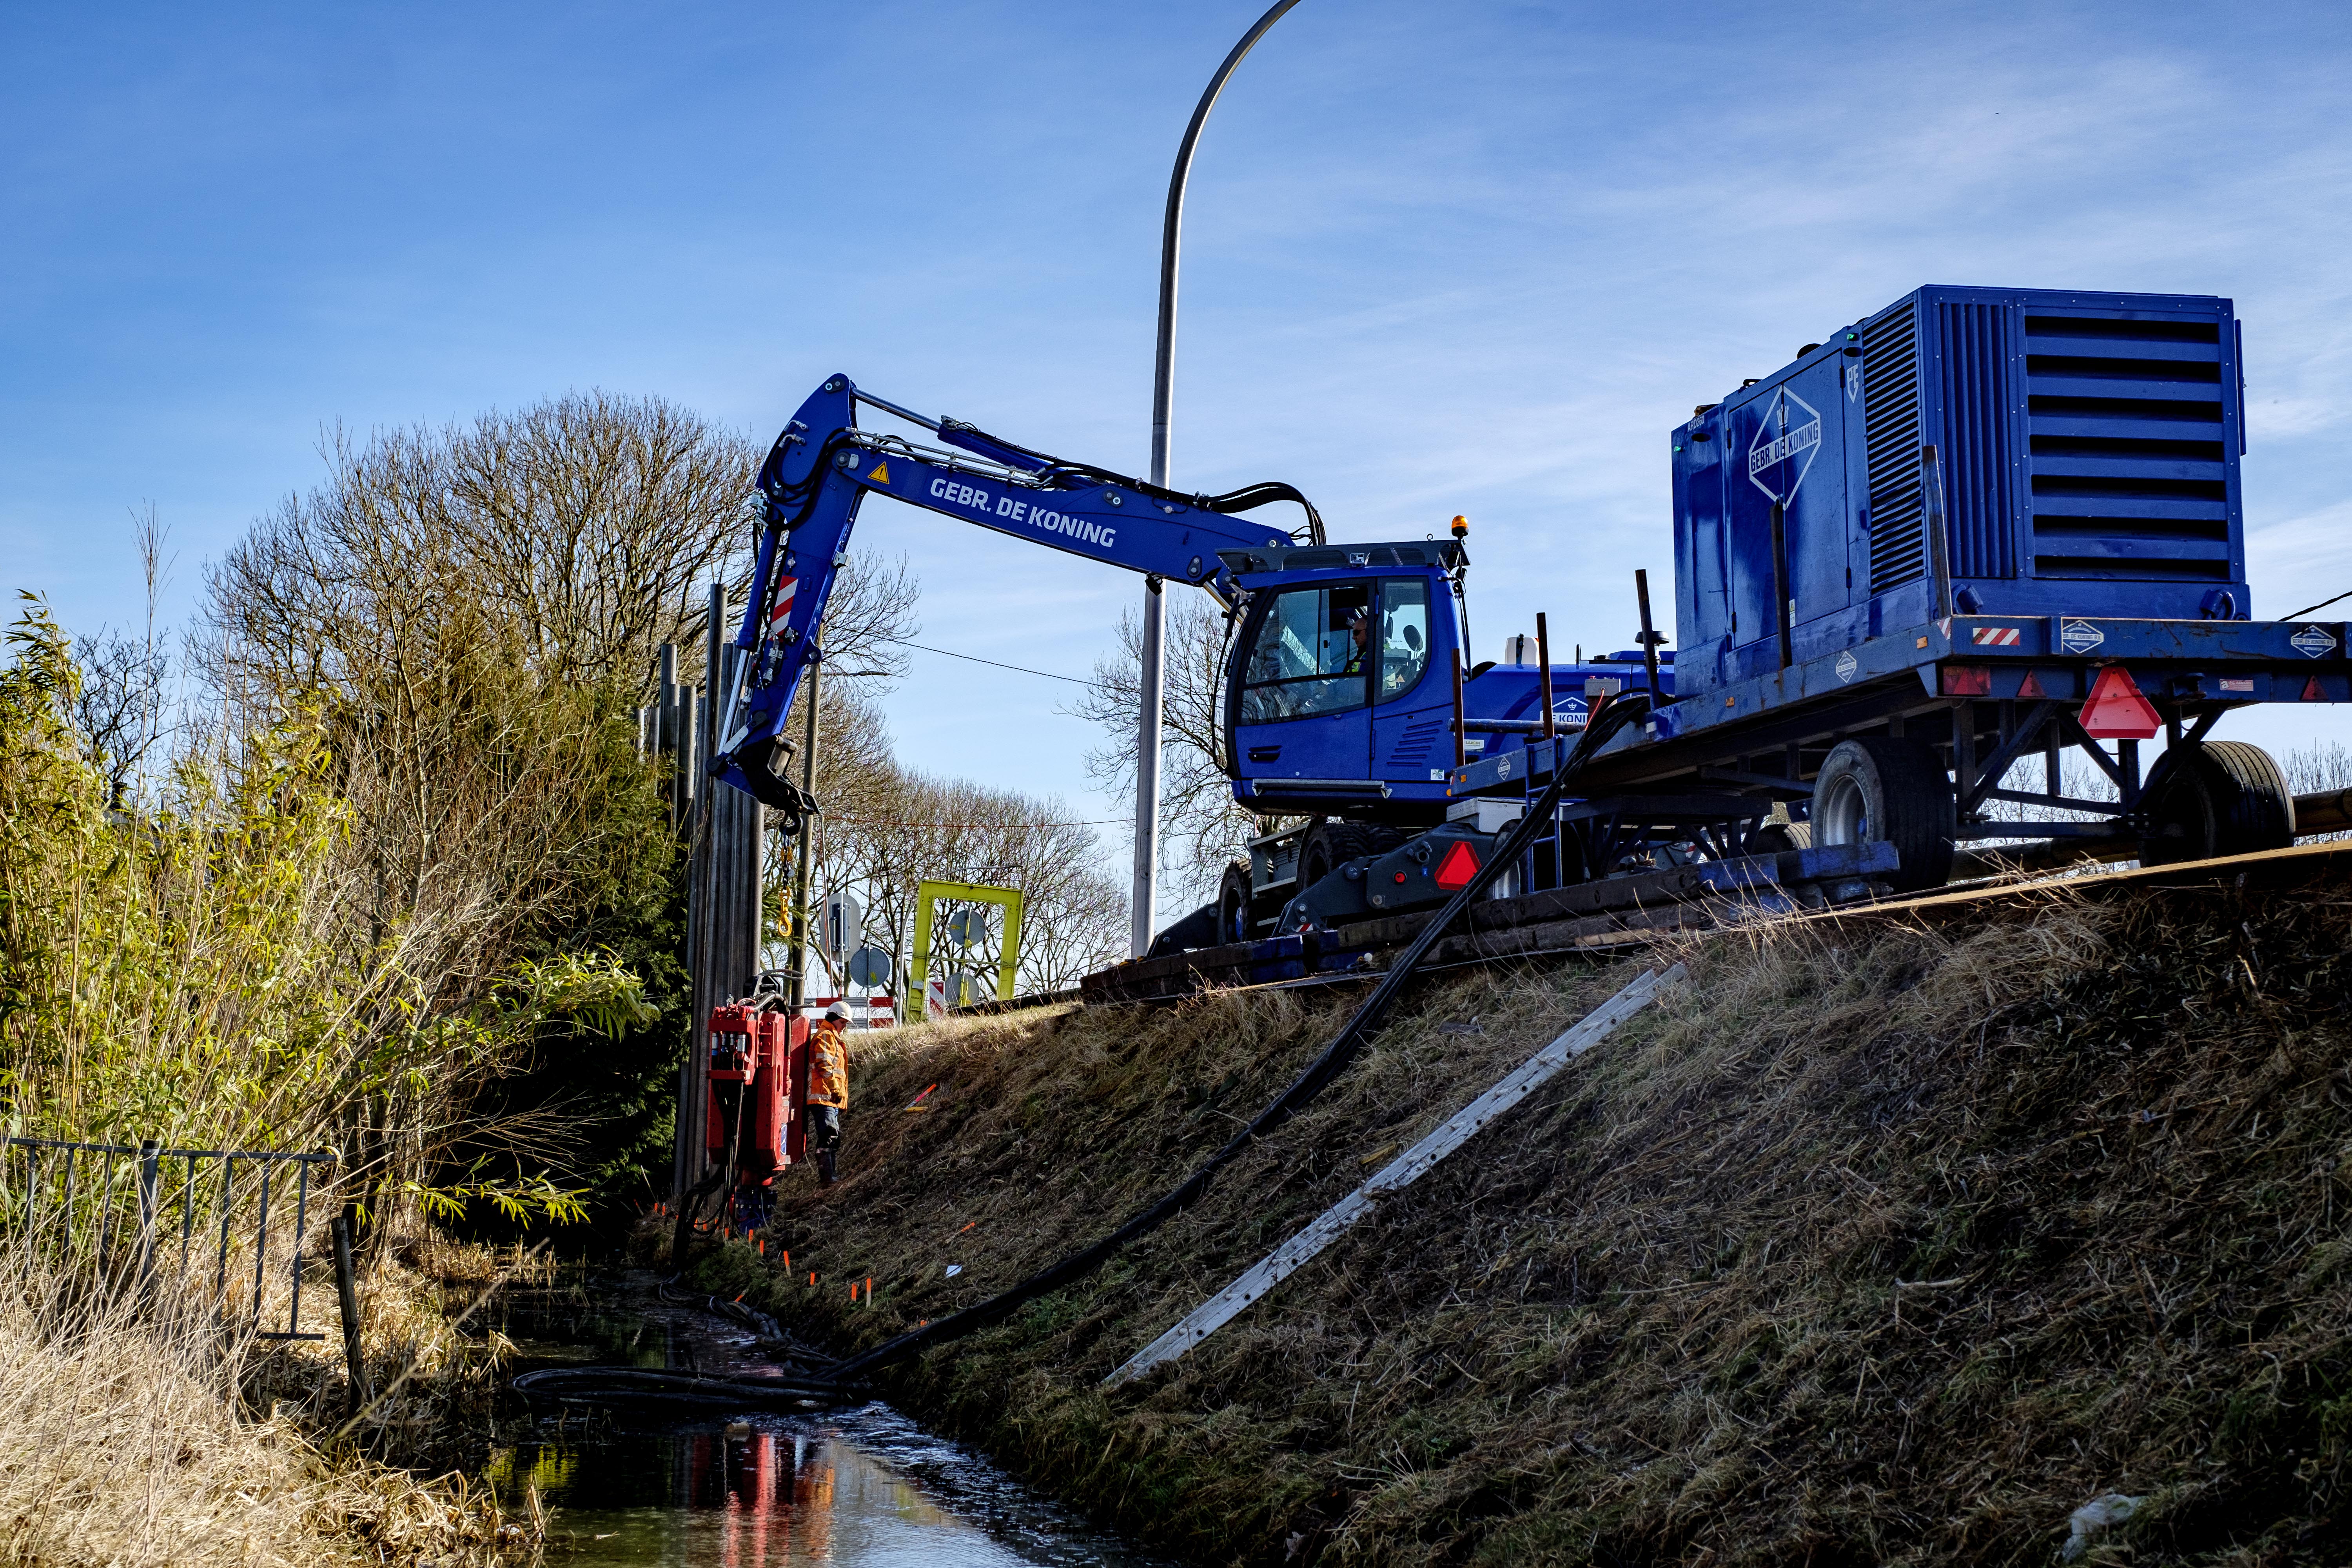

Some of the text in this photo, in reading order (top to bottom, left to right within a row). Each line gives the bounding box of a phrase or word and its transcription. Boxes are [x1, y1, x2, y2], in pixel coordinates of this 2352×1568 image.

[1751, 422, 1819, 472] GEBR. DE KONING
[930, 478, 1116, 547] GEBR. DE KONING
[1559, 714, 1586, 723] KONI
